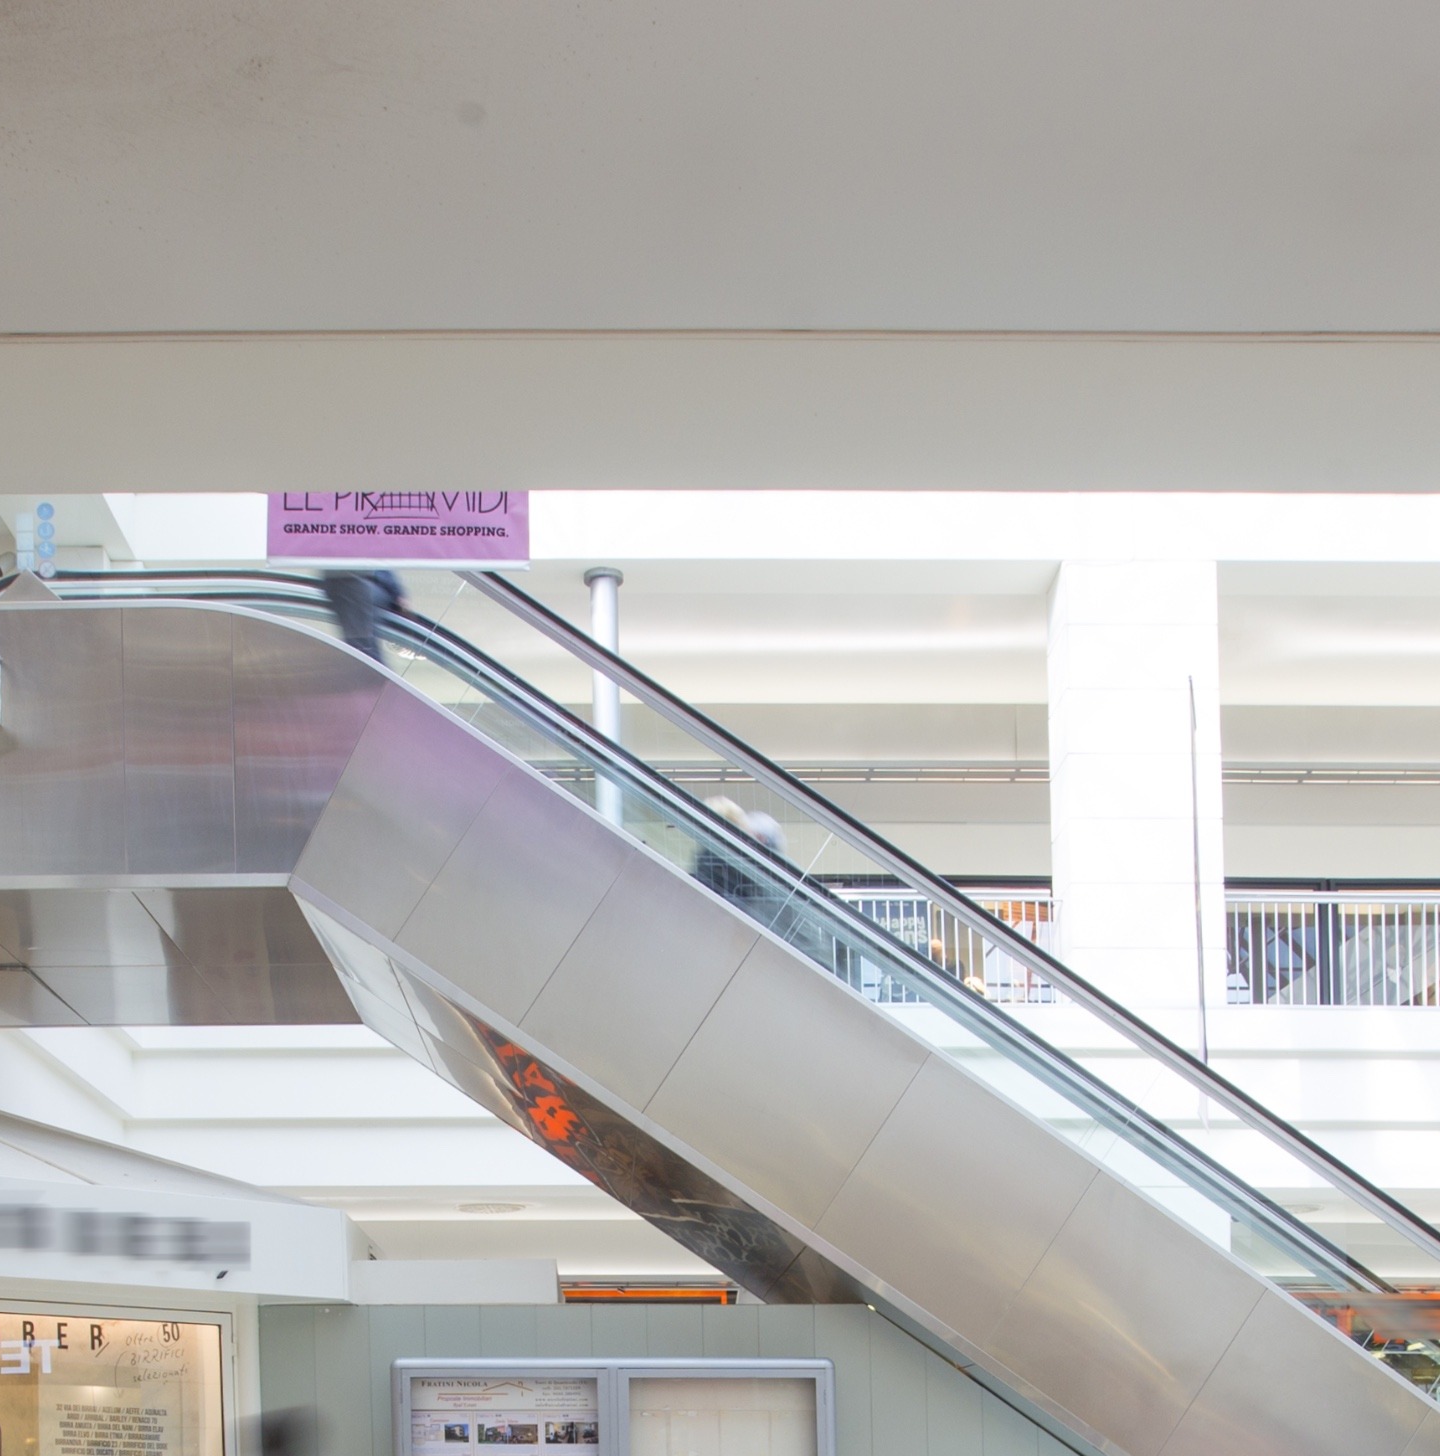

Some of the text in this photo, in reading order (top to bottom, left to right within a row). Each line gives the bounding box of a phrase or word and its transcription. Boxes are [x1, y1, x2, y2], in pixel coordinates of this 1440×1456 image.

[283, 523, 509, 538] GRANDE SHOW. GRANDE SHOPPING.
[162, 1323, 181, 1343] 50
